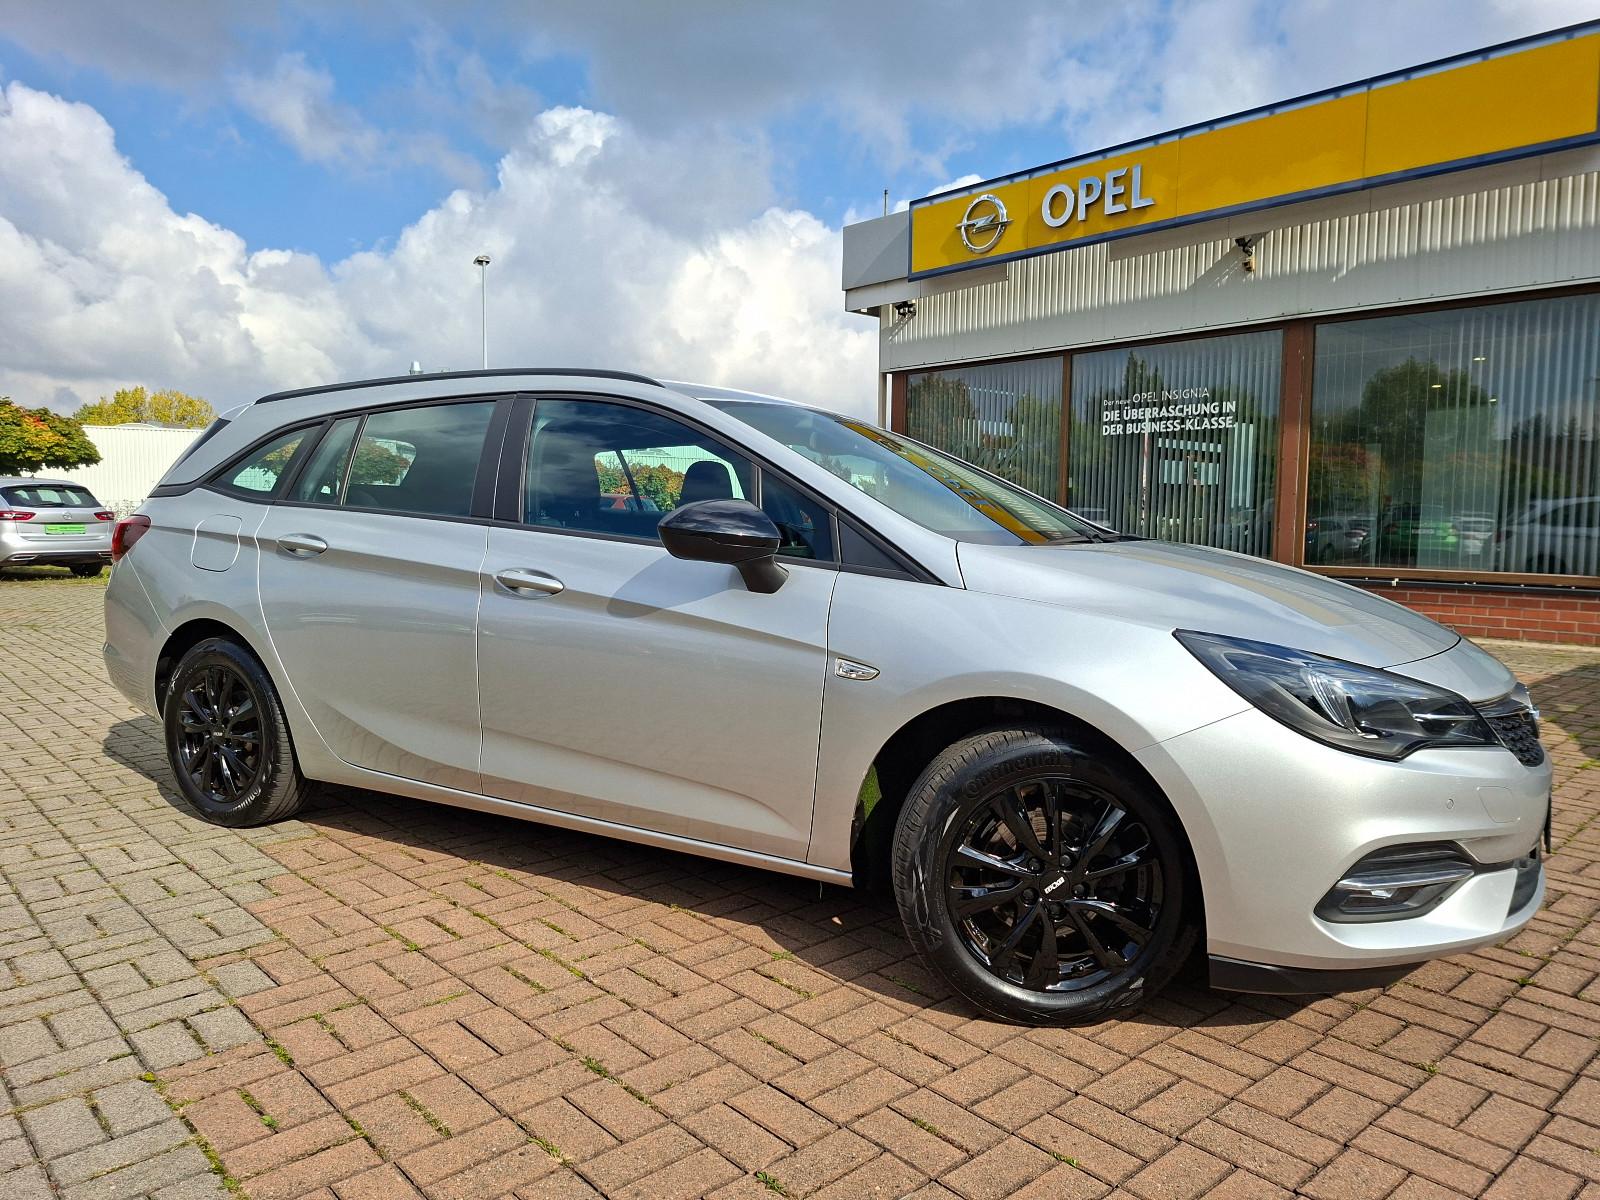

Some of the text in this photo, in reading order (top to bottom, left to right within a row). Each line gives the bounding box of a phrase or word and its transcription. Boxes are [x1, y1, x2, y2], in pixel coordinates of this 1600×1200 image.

[1041, 163, 1155, 228] OPEL
[1103, 399, 1115, 407] Der
[1132, 391, 1159, 403] OPEL
[1161, 387, 1210, 401] INSIGNIA
[1102, 400, 1236, 422] DIE ÜBERRASCHUNG IN
[1102, 424, 1124, 436] DER
